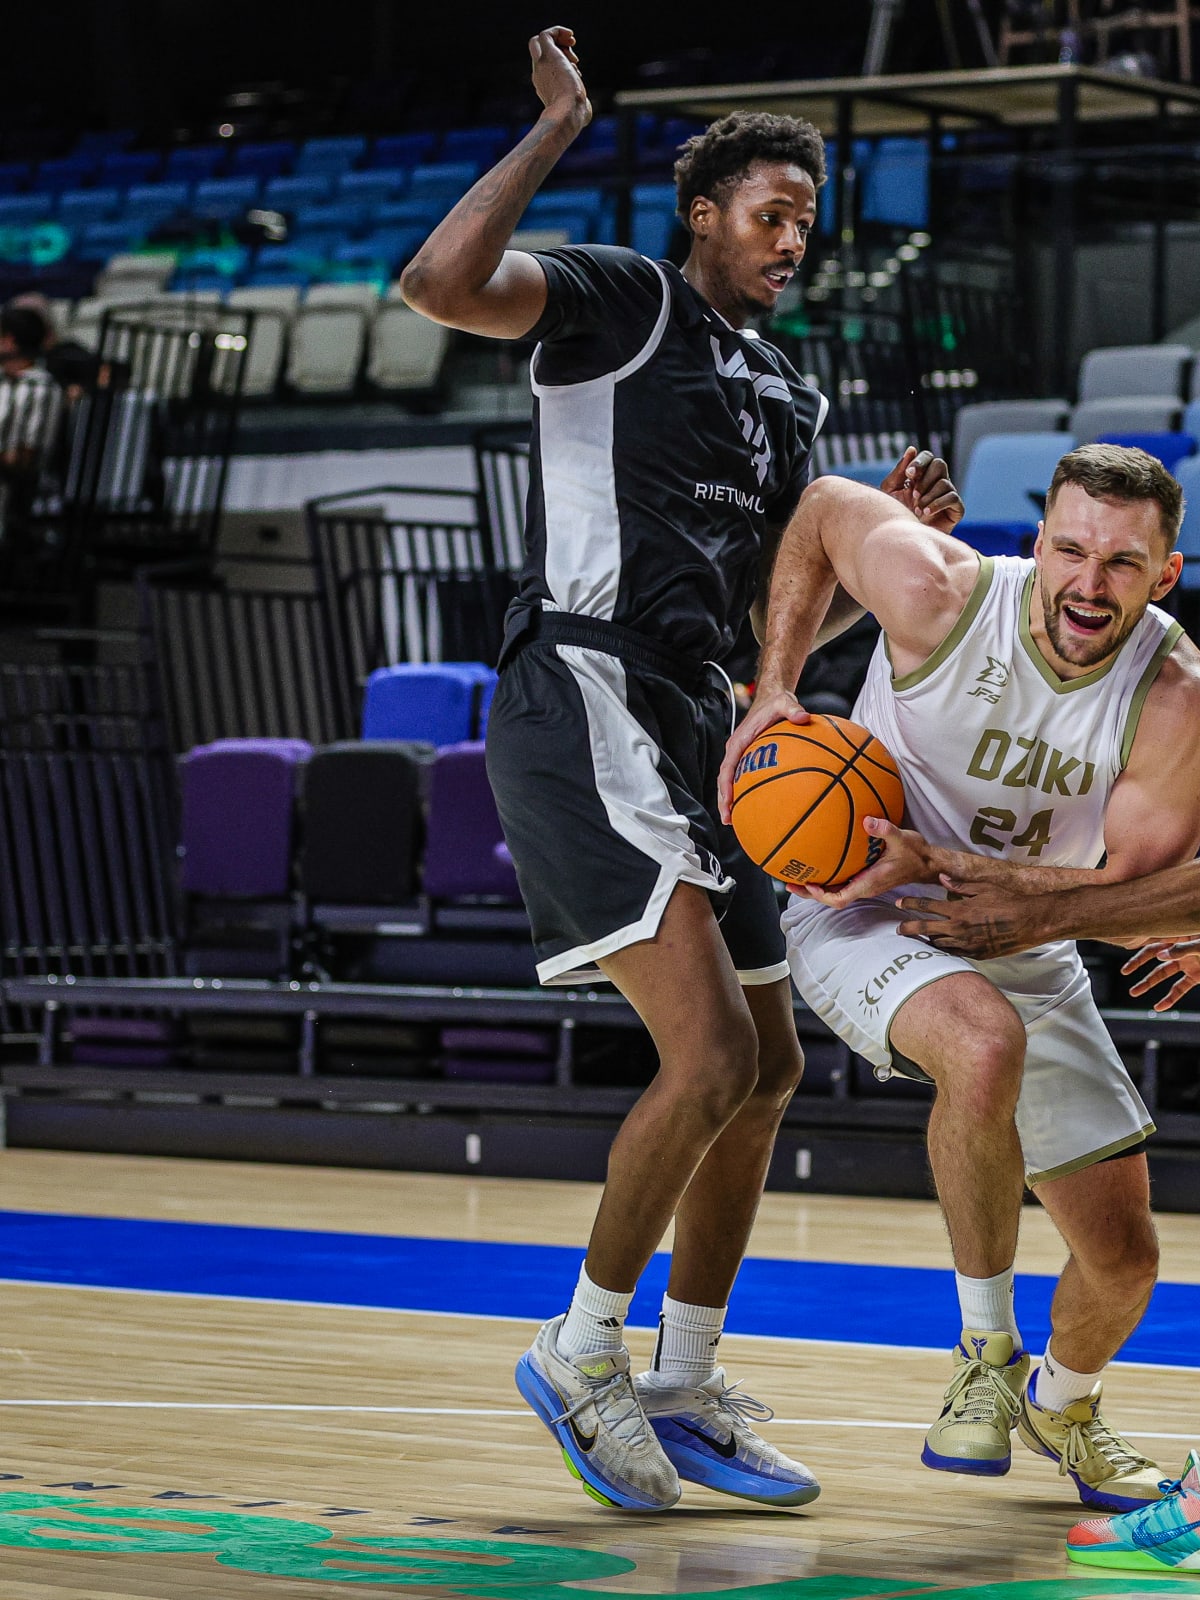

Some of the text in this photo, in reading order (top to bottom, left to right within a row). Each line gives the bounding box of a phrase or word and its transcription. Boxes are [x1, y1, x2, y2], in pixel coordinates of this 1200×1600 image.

[966, 686, 1003, 705] JFS
[968, 806, 1055, 857] 24
[873, 950, 949, 990] InPo
